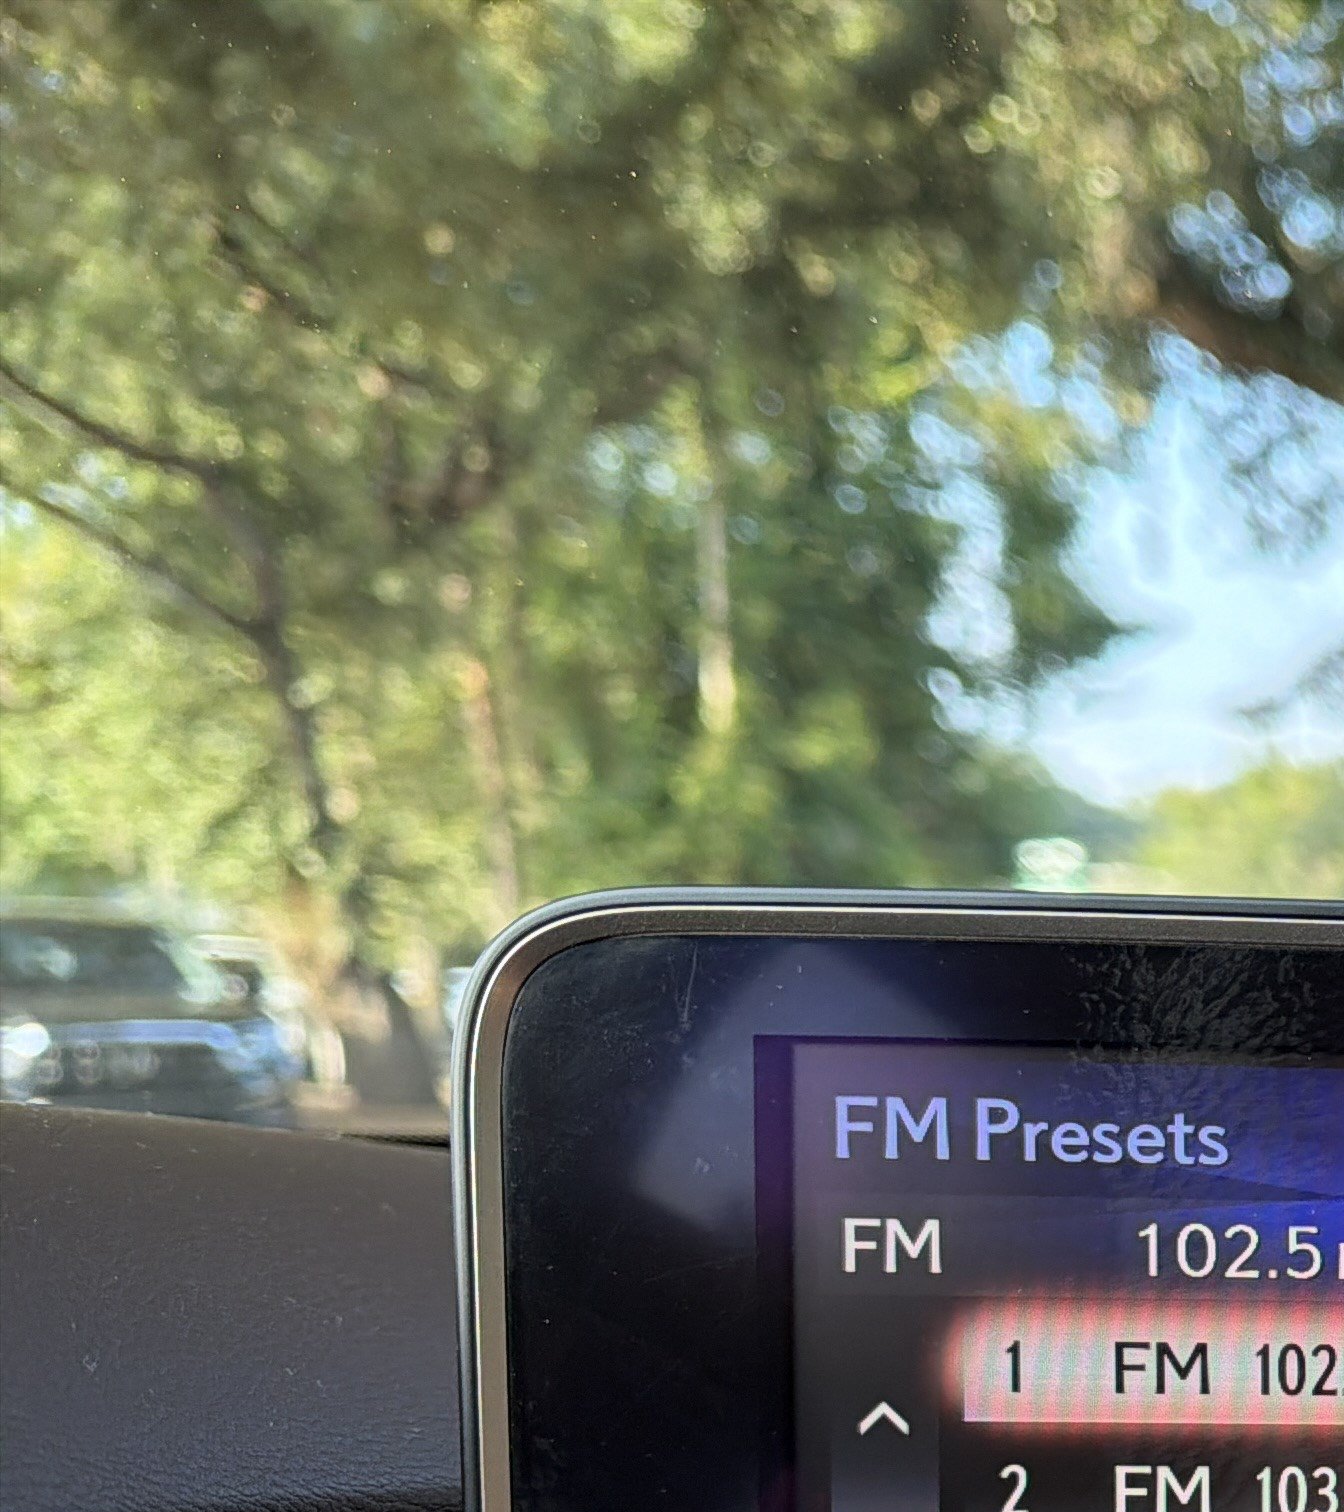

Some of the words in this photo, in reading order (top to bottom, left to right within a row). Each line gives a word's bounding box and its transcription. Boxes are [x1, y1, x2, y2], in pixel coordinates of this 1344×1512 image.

[833, 1096, 950, 1161] FM
[975, 1097, 1231, 1166] Presets
[842, 1217, 943, 1275] FM
[1138, 1223, 1323, 1280] 102.5
[1005, 1339, 1022, 1393] 1
[1113, 1341, 1212, 1396] FM
